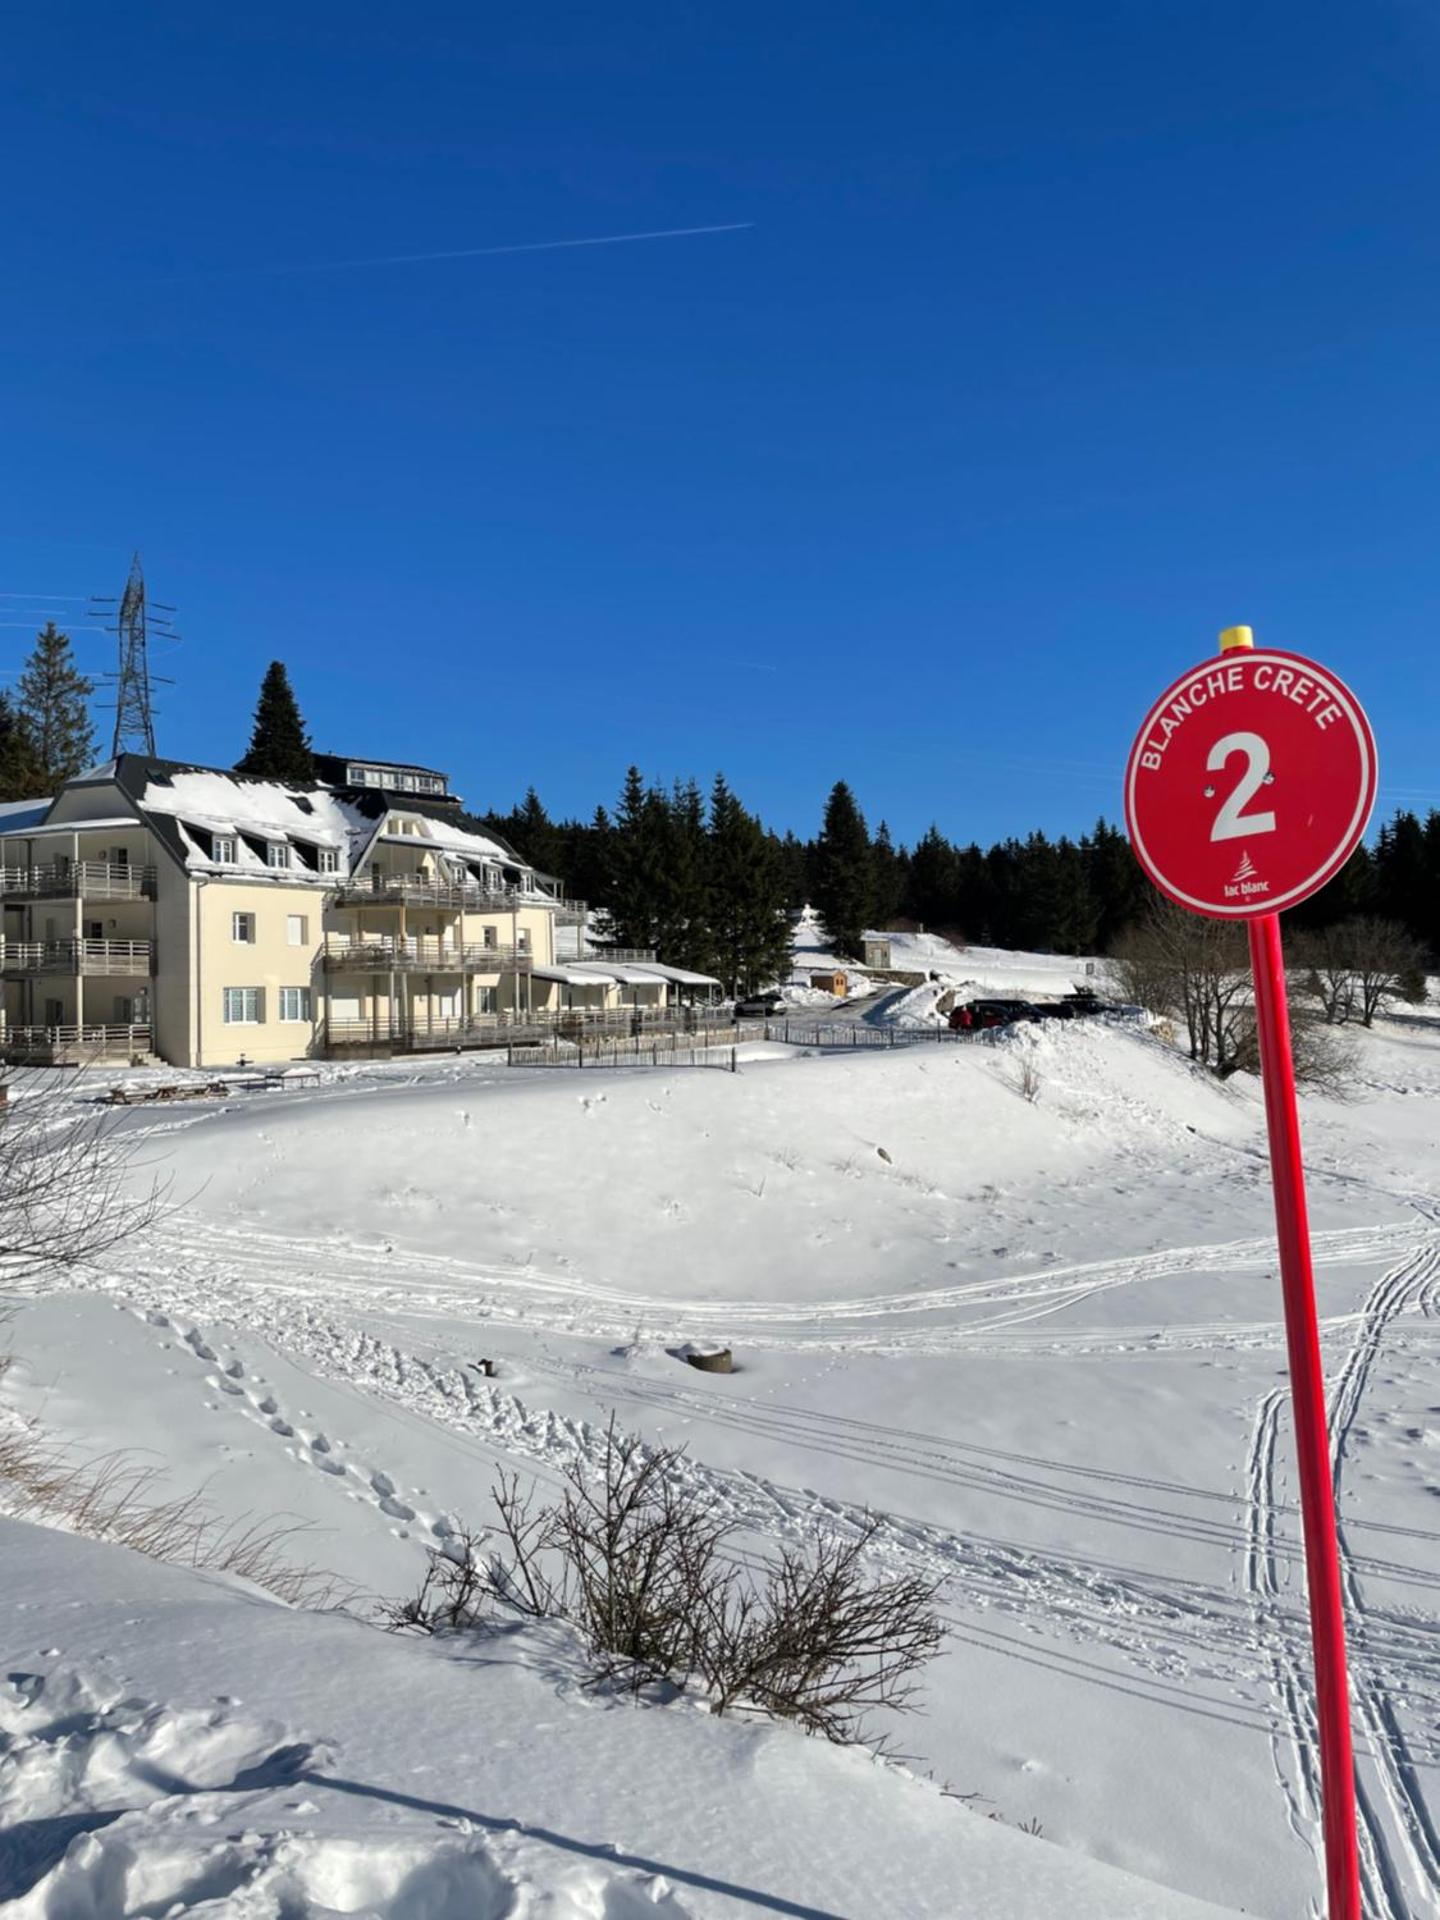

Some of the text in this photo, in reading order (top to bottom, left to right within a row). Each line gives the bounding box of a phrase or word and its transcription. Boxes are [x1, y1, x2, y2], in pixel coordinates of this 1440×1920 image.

[1141, 665, 1343, 771] BLANCHE CRETE
[1206, 731, 1277, 842] 2
[1240, 880, 1270, 895] blanc
